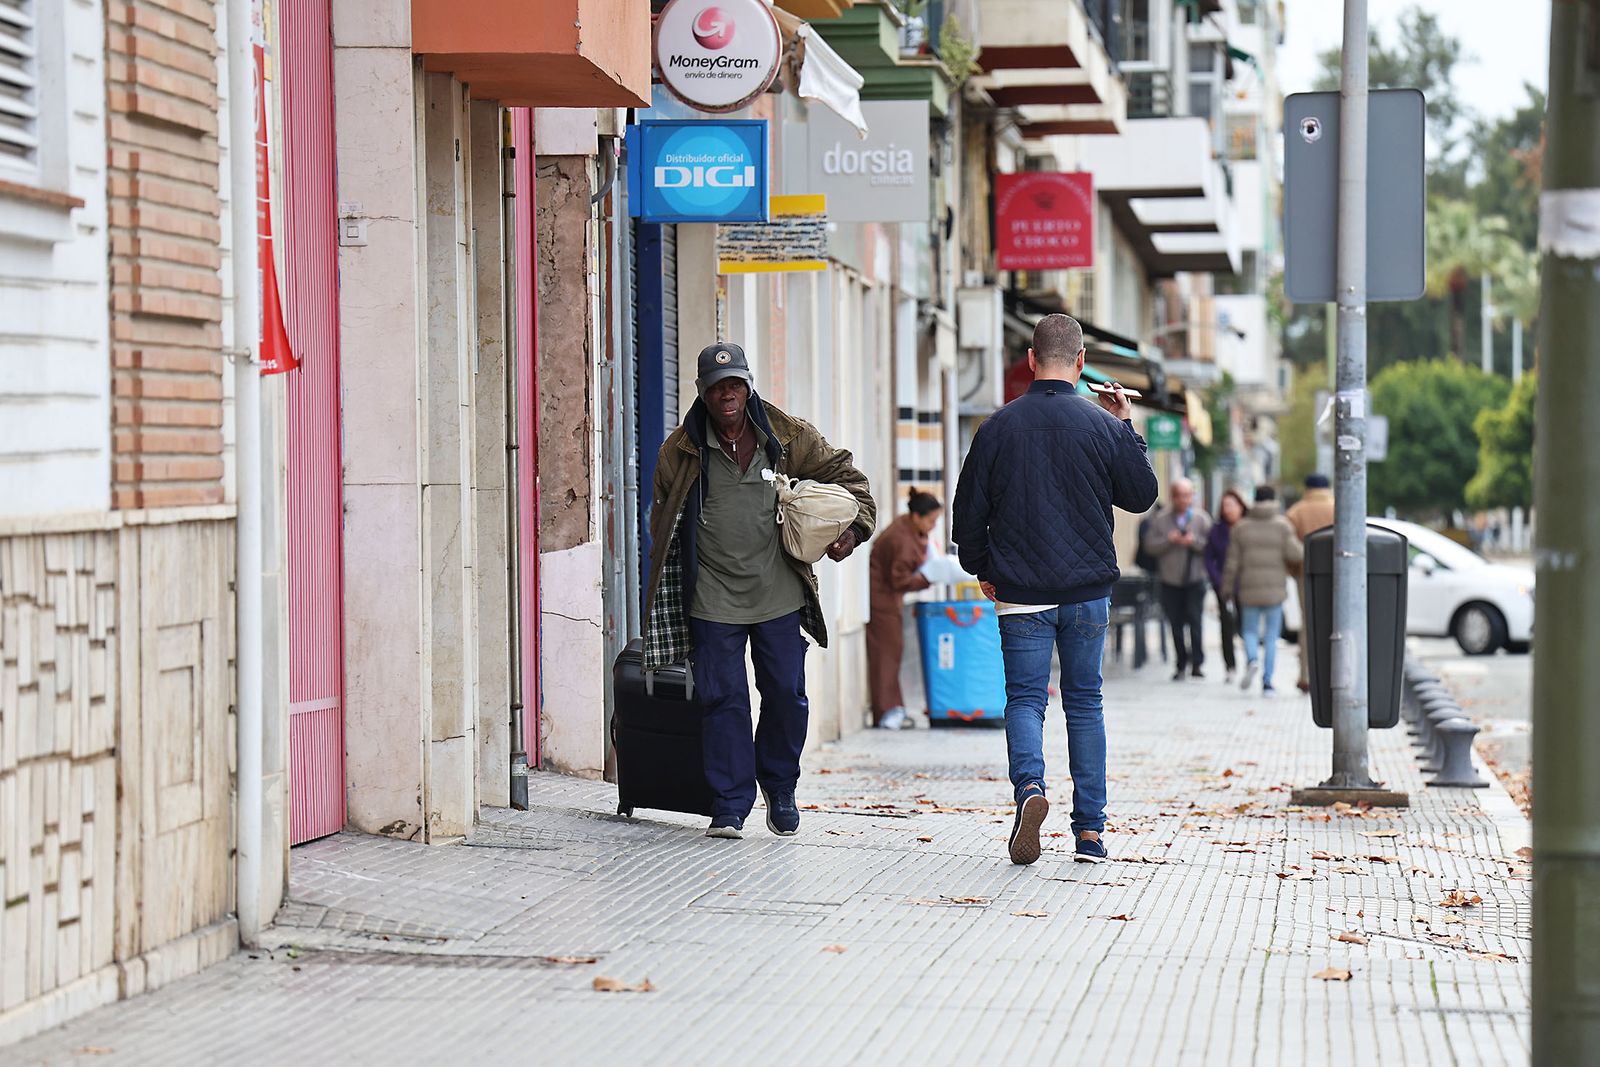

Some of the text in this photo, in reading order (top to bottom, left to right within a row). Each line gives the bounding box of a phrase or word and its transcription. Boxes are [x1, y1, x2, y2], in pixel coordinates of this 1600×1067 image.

[669, 55, 759, 70] MoneyGram
[706, 71, 716, 79] de
[717, 71, 743, 79] dinero
[665, 153, 744, 163] Distribuidor oficial
[823, 141, 914, 174] dorsia
[654, 166, 755, 187] DIGI
